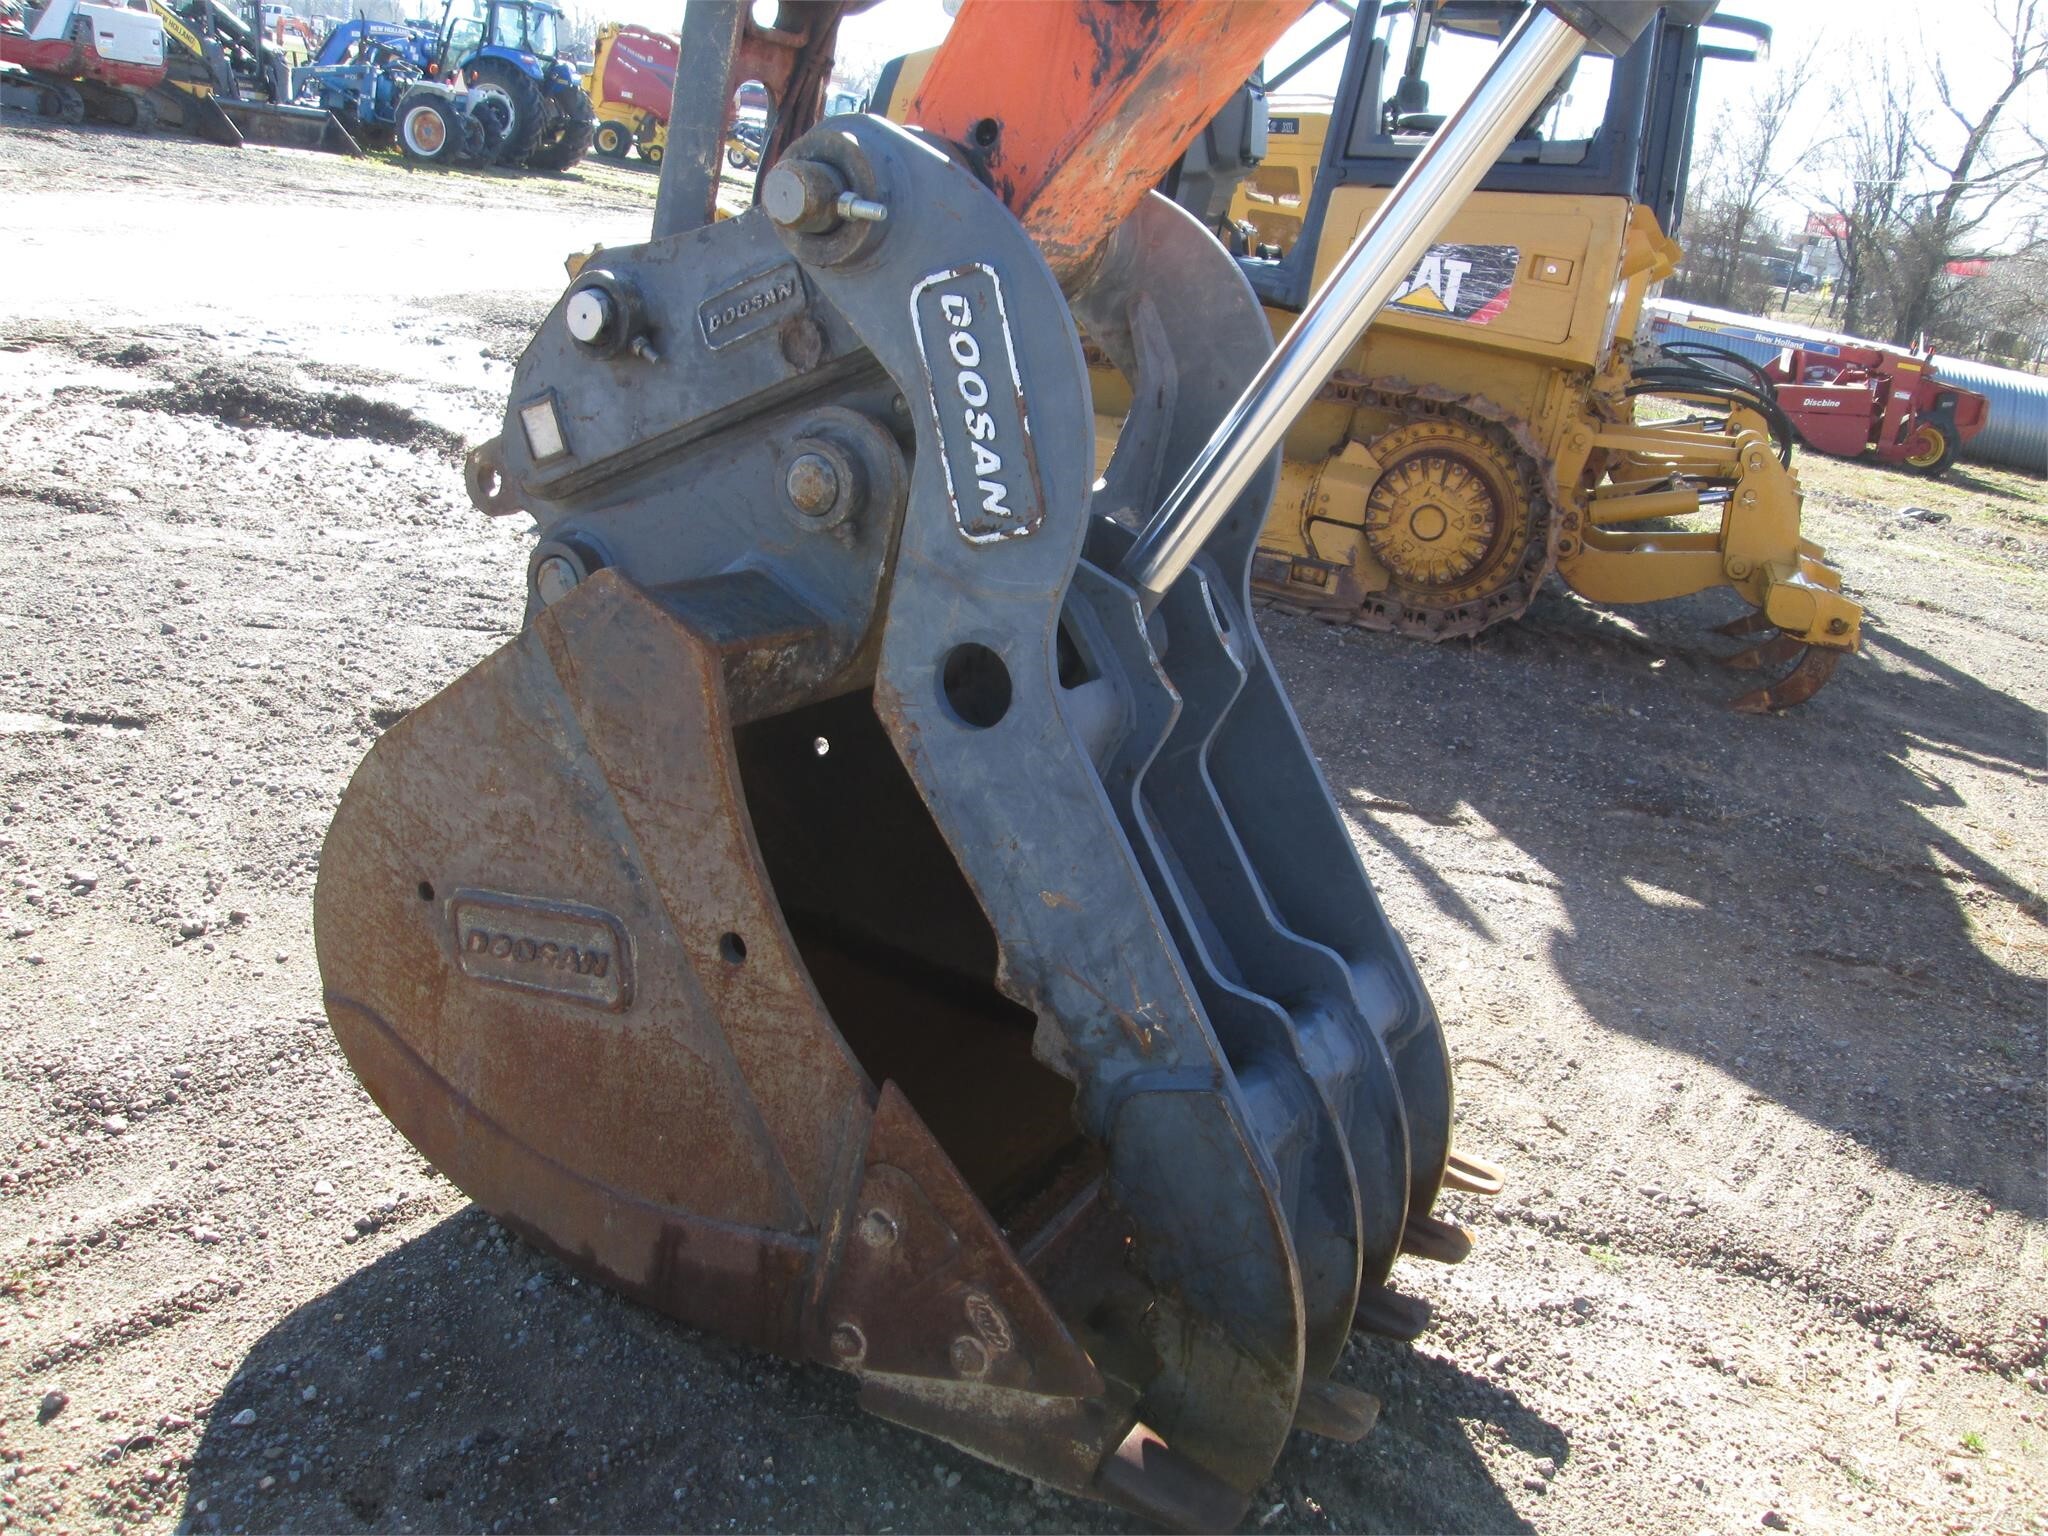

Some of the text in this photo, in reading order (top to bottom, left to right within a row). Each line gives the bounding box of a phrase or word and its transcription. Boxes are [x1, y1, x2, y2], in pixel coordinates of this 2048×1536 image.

[168, 19, 196, 46] HOLLAND
[1390, 255, 1473, 312] AT
[709, 278, 796, 333] DOOSAN
[1755, 334, 1804, 349] New Holland
[941, 294, 1013, 517] DOOSAN
[1803, 398, 1841, 408] Discbine
